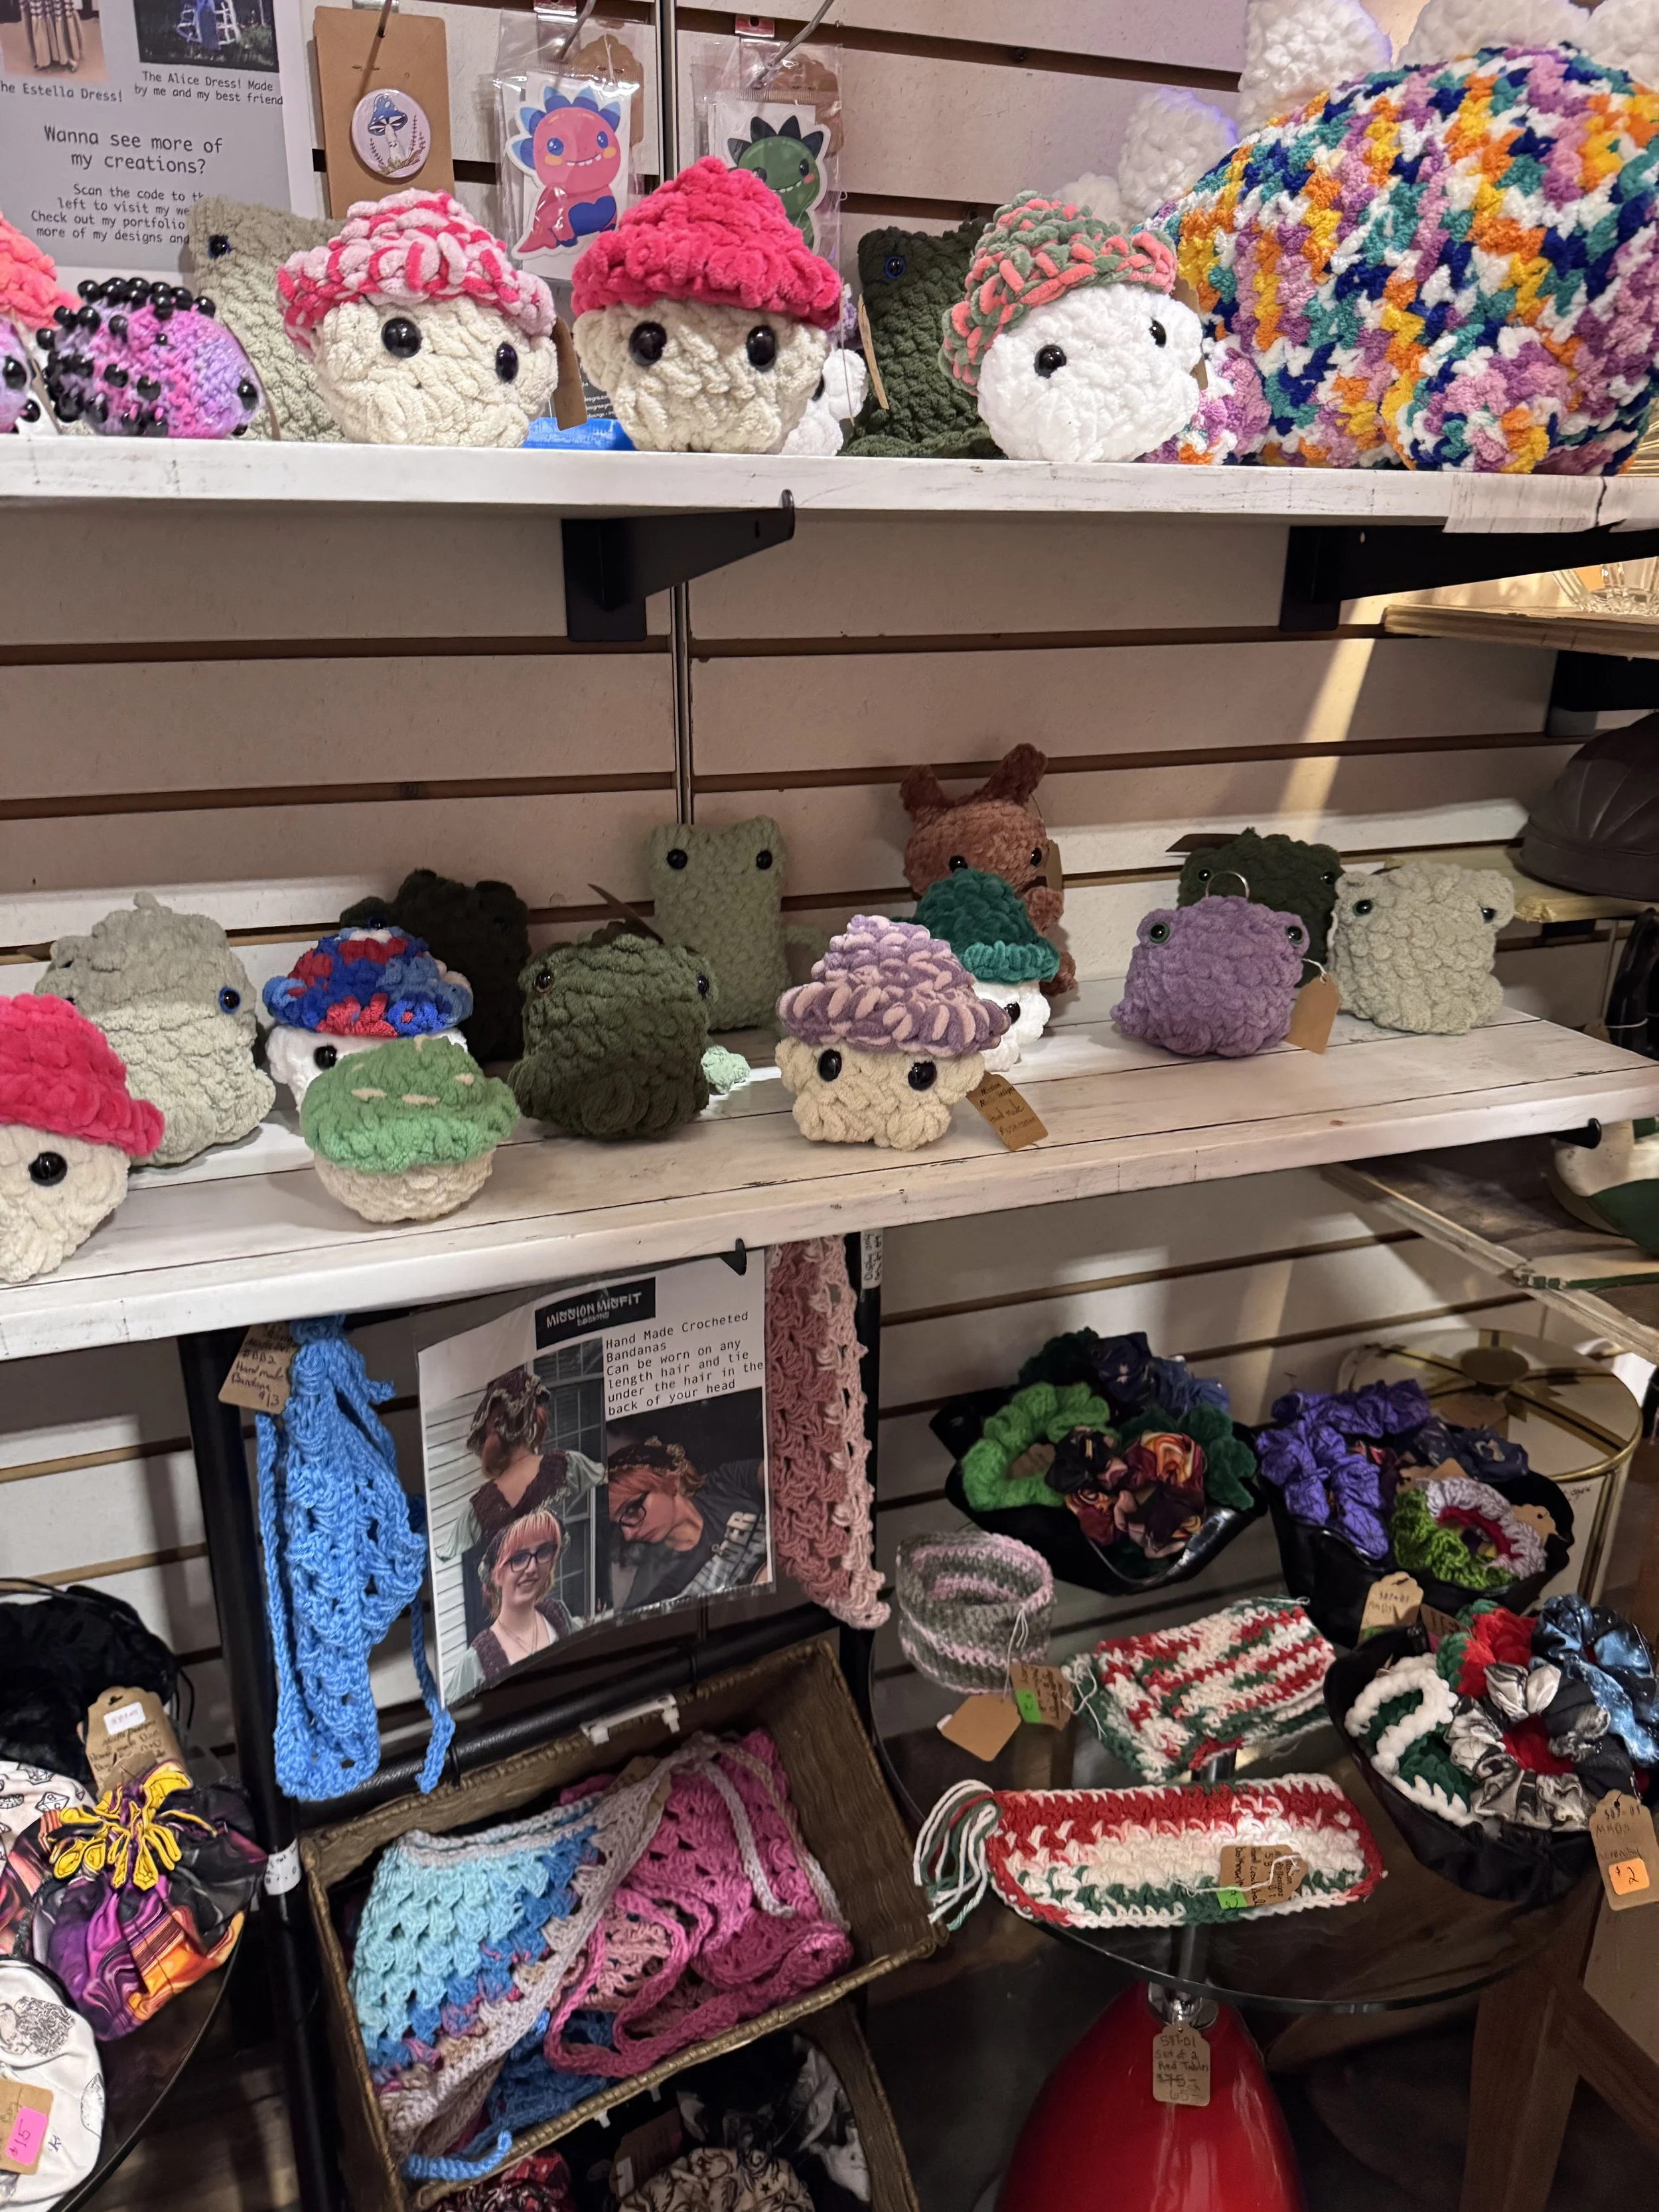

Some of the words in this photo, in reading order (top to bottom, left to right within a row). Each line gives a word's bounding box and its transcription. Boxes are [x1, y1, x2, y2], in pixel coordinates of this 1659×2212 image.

[0, 80, 15, 94] he
[23, 83, 74, 98] Estella
[81, 88, 122, 102] Dress!
[142, 70, 162, 82] The
[167, 73, 199, 85] Alice
[205, 76, 241, 89] Dress!
[248, 80, 273, 92] Made
[135, 83, 147, 97] by
[153, 88, 166, 96] me
[173, 88, 191, 98] and
[197, 92, 210, 102] my
[216, 91, 240, 102] best
[247, 93, 283, 106] friend
[44, 123, 100, 145] Wanna
[110, 133, 141, 148] see
[151, 137, 193, 152] more
[203, 137, 223, 153] of
[71, 153, 93, 170] my
[104, 155, 206, 175] creations?
[74, 184, 102, 197] Scan
[110, 186, 130, 198] the
[137, 188, 165, 200] code
[171, 191, 185, 202] to
[58, 197, 86, 210] left
[94, 200, 108, 211] to
[114, 200, 149, 214] visit
[155, 206, 170, 216] my
[176, 208, 190, 216] we
[31, 210, 67, 223] Check
[74, 214, 96, 225] out
[102, 218, 116, 228] my
[123, 217, 185, 230] portfolio
[36, 228, 65, 237] more
[72, 228, 85, 238] of
[93, 232, 107, 242] my
[115, 230, 163, 245] designs
[169, 234, 190, 245] and
[606, 1334, 636, 1349] Hand
[644, 1326, 674, 1341] Made
[682, 1311, 749, 1333] Crocheted
[607, 1342, 667, 1363] Bandanas
[607, 1363, 629, 1376] Can
[638, 1358, 652, 1369] be
[660, 1351, 690, 1364] worn
[697, 1345, 712, 1357] on
[720, 1339, 741, 1351] any
[608, 1371, 653, 1389] length
[661, 1363, 690, 1378] hair
[699, 1356, 720, 1369] and
[729, 1351, 749, 1363] tie
[608, 1386, 644, 1402] under
[655, 1379, 676, 1392] the
[684, 1372, 712, 1386] hair
[722, 1367, 735, 1377] in
[744, 1361, 764, 1372] the
[609, 1401, 638, 1416] back
[646, 1394, 661, 1406] of
[670, 1388, 697, 1404] your
[707, 1379, 736, 1394] head
